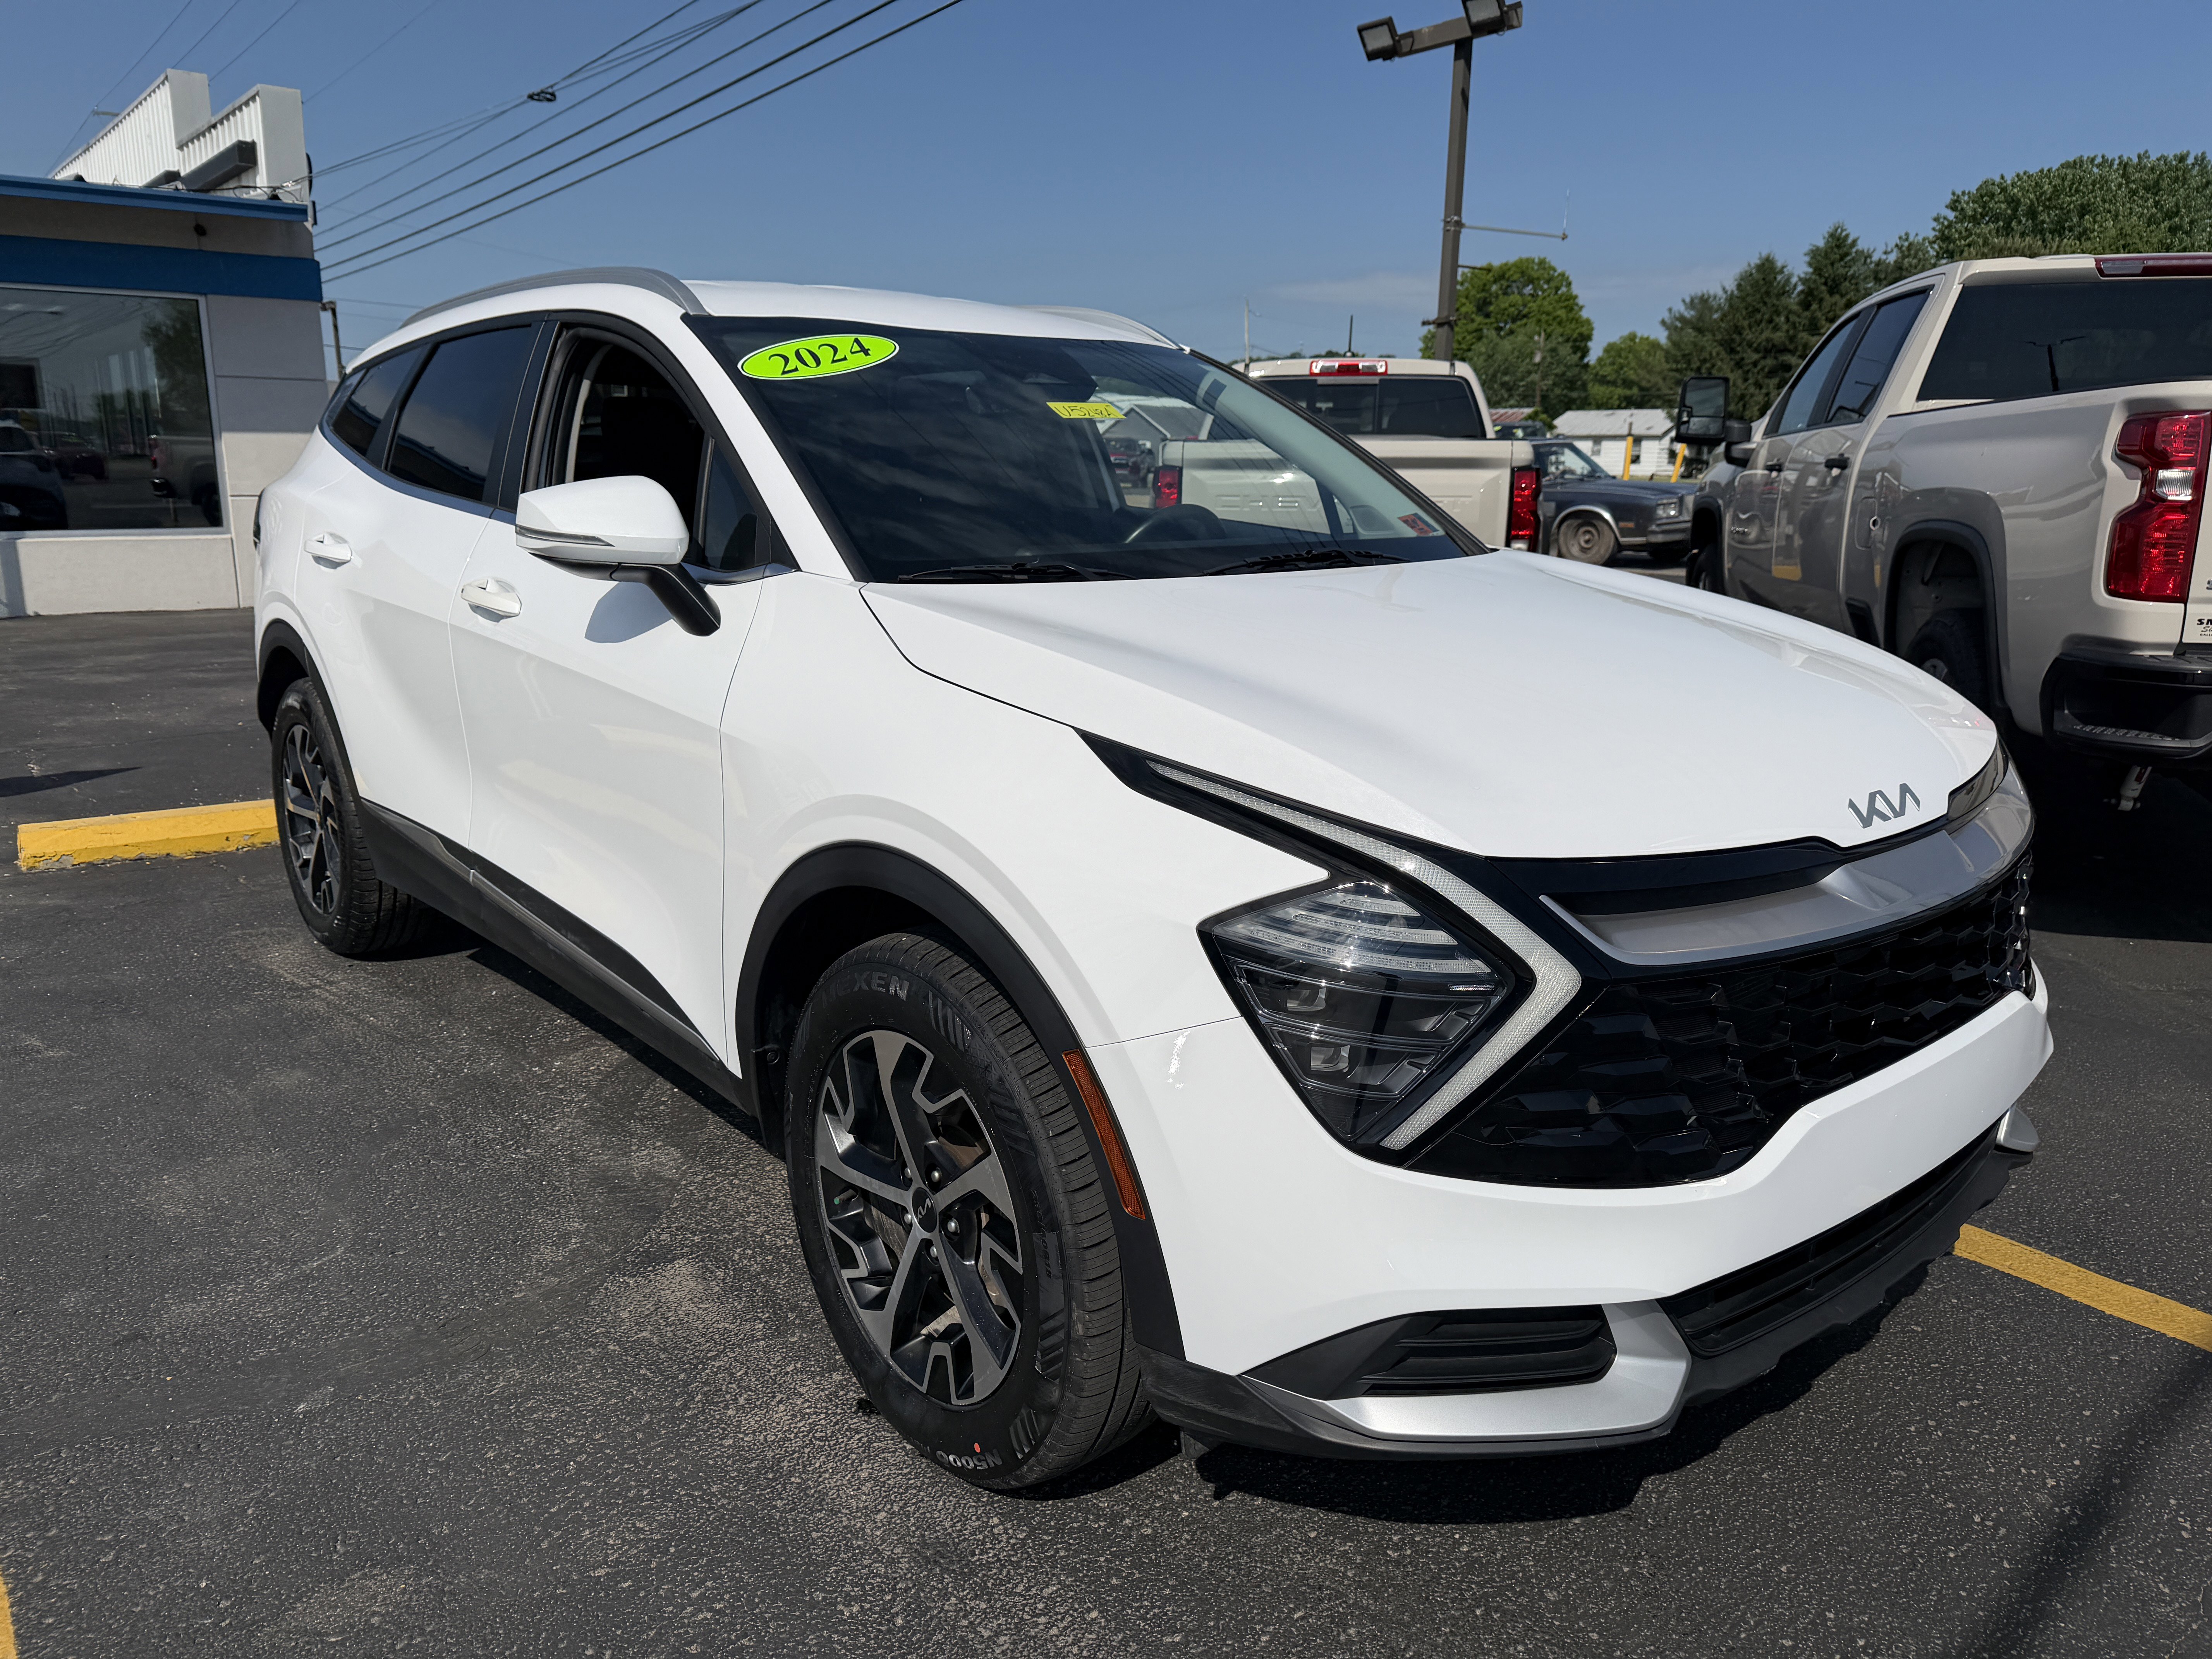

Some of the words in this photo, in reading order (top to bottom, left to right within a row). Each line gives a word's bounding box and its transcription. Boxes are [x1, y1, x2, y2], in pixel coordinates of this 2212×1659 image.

[769, 337, 871, 376] 2024
[1848, 783, 1920, 829] KIA
[822, 971, 910, 1009] NEXEN
[936, 1448, 1002, 1470] N5000
